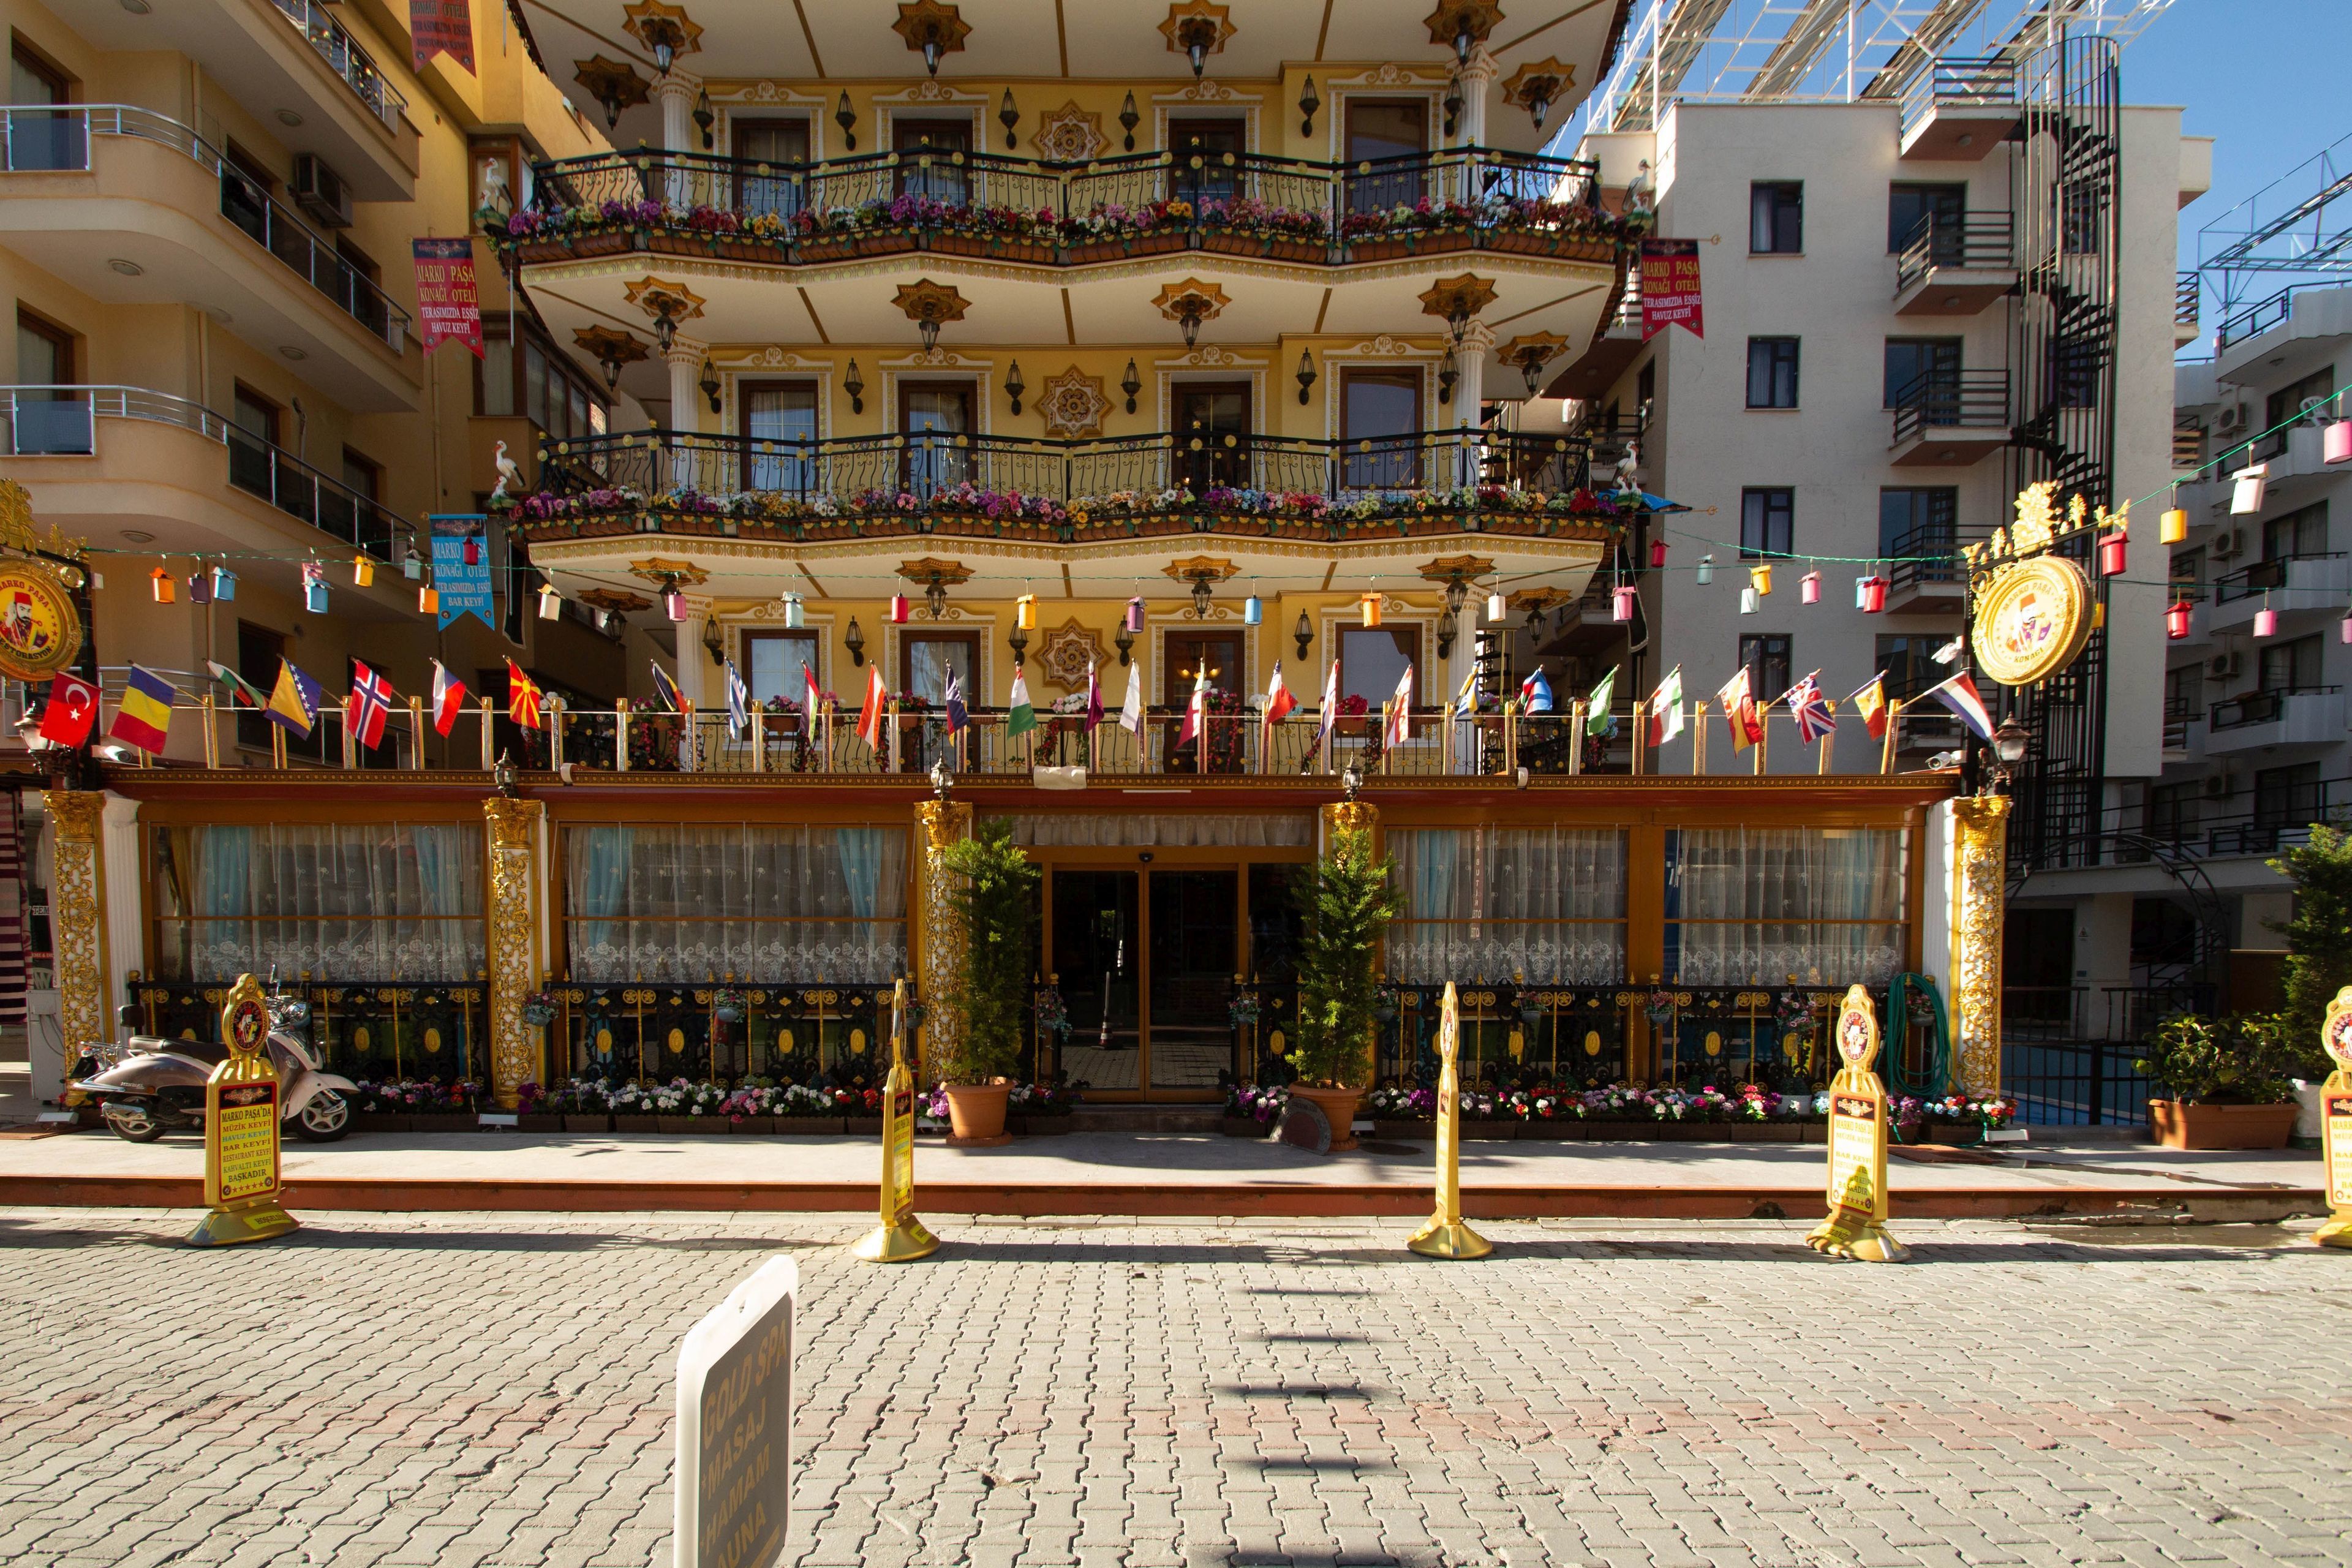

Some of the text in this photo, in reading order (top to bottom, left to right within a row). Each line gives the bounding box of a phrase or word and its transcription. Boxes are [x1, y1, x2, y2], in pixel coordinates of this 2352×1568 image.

[417, 265, 475, 285] MARKO PAŞA
[1643, 260, 1699, 279] MARKO PAŞA
[420, 284, 477, 303] KONAĞI OTELİ
[1643, 278, 1700, 294] KONAĞI OTELİ
[1643, 296, 1683, 308] TERASIMIZDA
[421, 307, 461, 318] TERASIMIZDA
[1652, 307, 1691, 320] HAVUZ KEYFİ
[431, 321, 470, 334] HAVUZ KEYFİ
[433, 542, 461, 559] MARKO
[435, 561, 489, 578] KONAĞI OTELİ
[437, 582, 476, 594] TERASIMIZDA
[448, 595, 484, 607] BAR KEYFİ
[0, 638, 53, 660] ESTORASYON
[222, 1110, 244, 1123] MARKO
[223, 1120, 271, 1133] MÜZİK KEYFİ
[222, 1129, 270, 1143] HAVUZ KEYFİ
[243, 1138, 271, 1148] KEYFİ
[223, 1147, 271, 1163] RESTAURANT KEYFİ
[223, 1157, 271, 1174] KAHVALTI KEYFİ
[228, 1169, 266, 1184] BAŞKADIR
[704, 1319, 787, 1450] GOLD SPA
